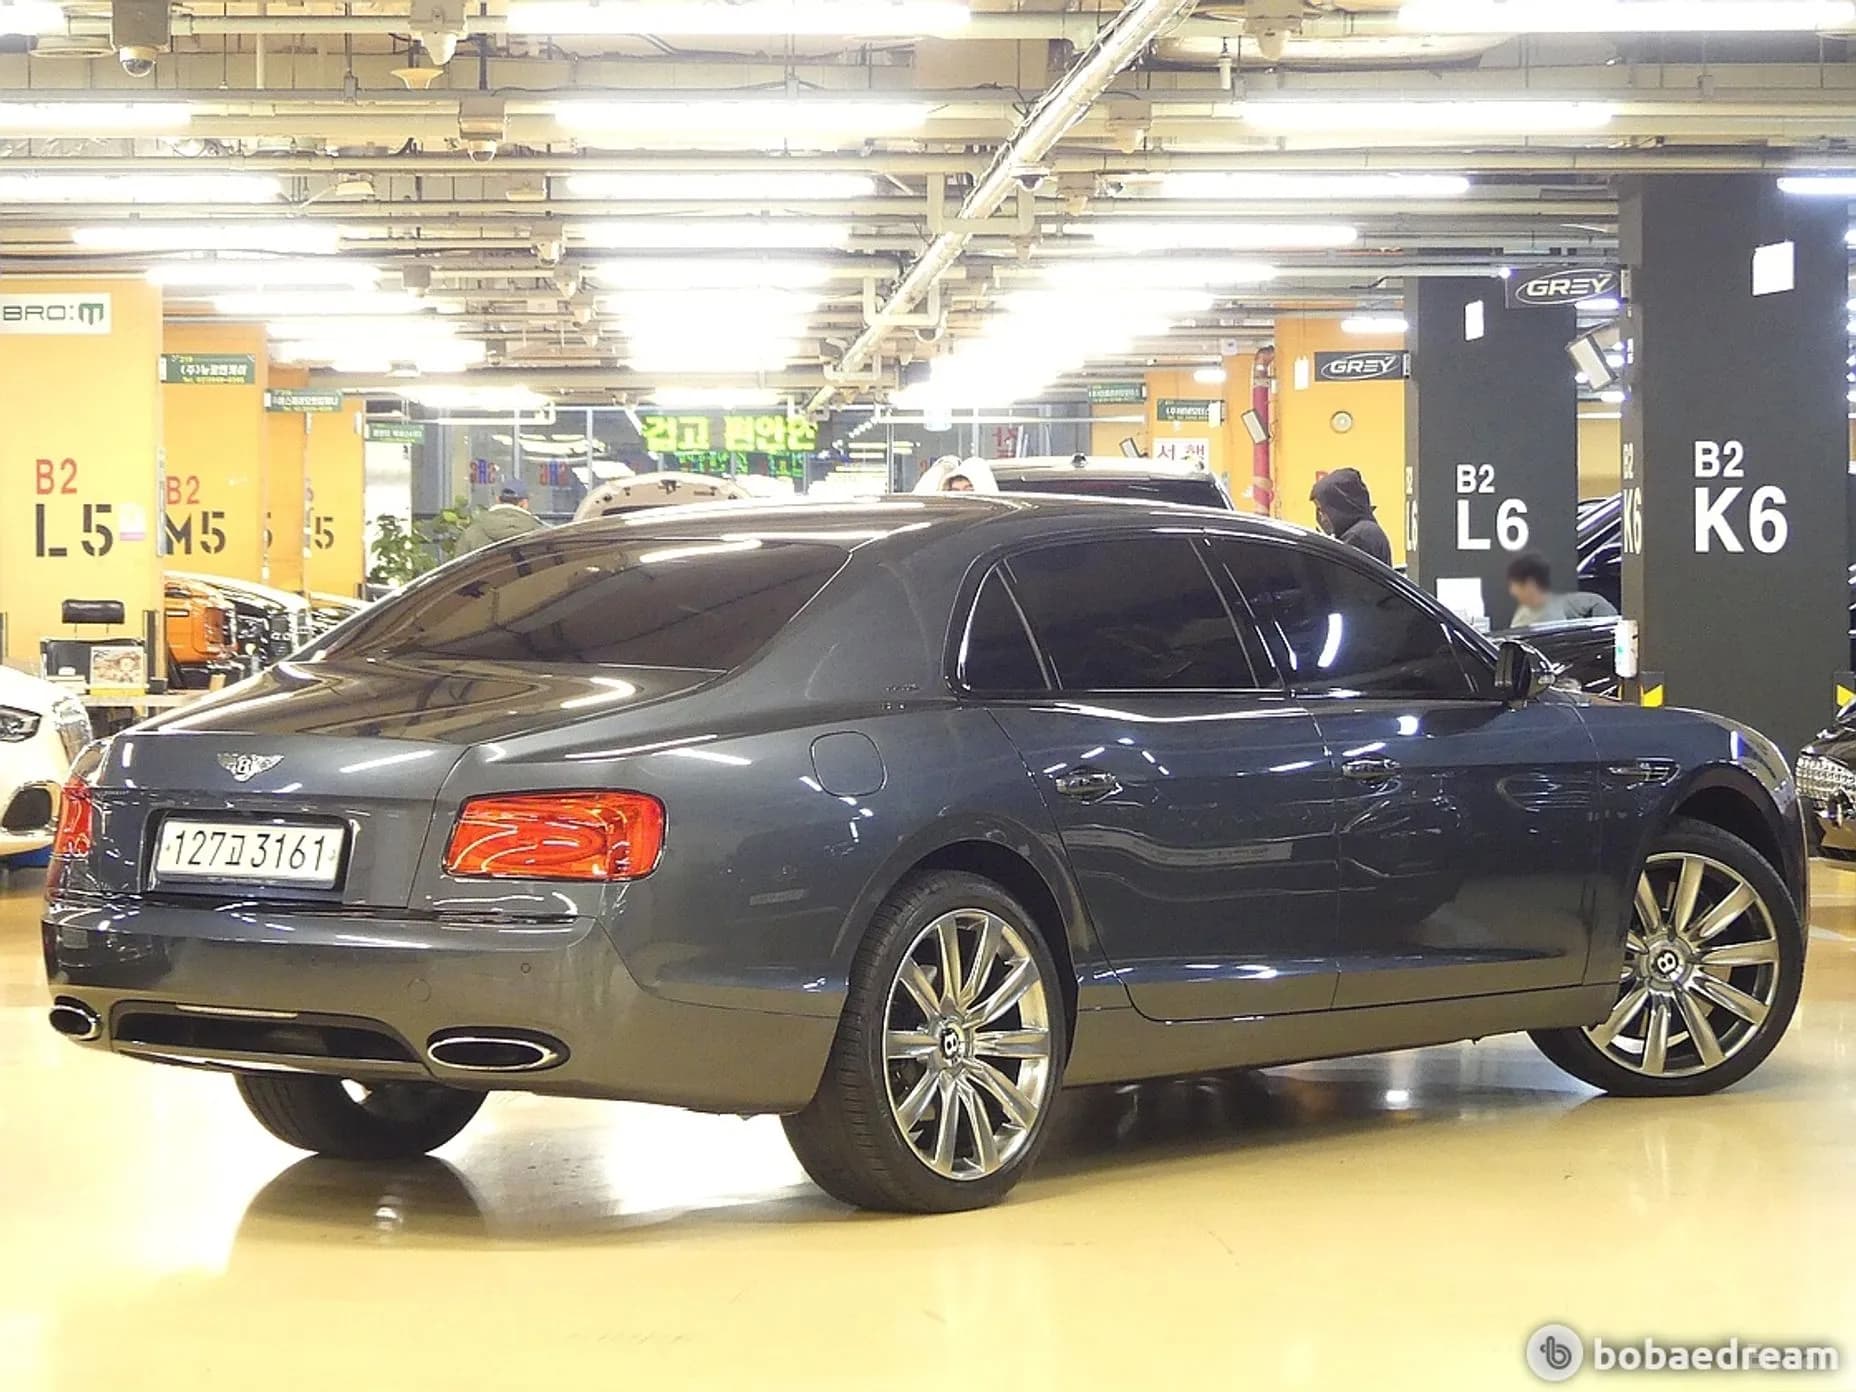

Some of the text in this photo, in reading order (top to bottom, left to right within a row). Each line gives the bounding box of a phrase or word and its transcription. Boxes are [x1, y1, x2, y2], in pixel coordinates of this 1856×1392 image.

[1527, 273, 1612, 296] GREY
[1330, 356, 1397, 374] GREY
[36, 457, 77, 494] B2
[1456, 464, 1495, 493] B2
[1695, 440, 1745, 478] B2
[166, 475, 200, 505] B2
[36, 504, 113, 557] L5
[165, 511, 226, 555] M5
[1457, 498, 1529, 550] L6
[1623, 487, 1642, 554] K6
[1695, 485, 1788, 554] K6
[176, 829, 325, 871] 127고3161
